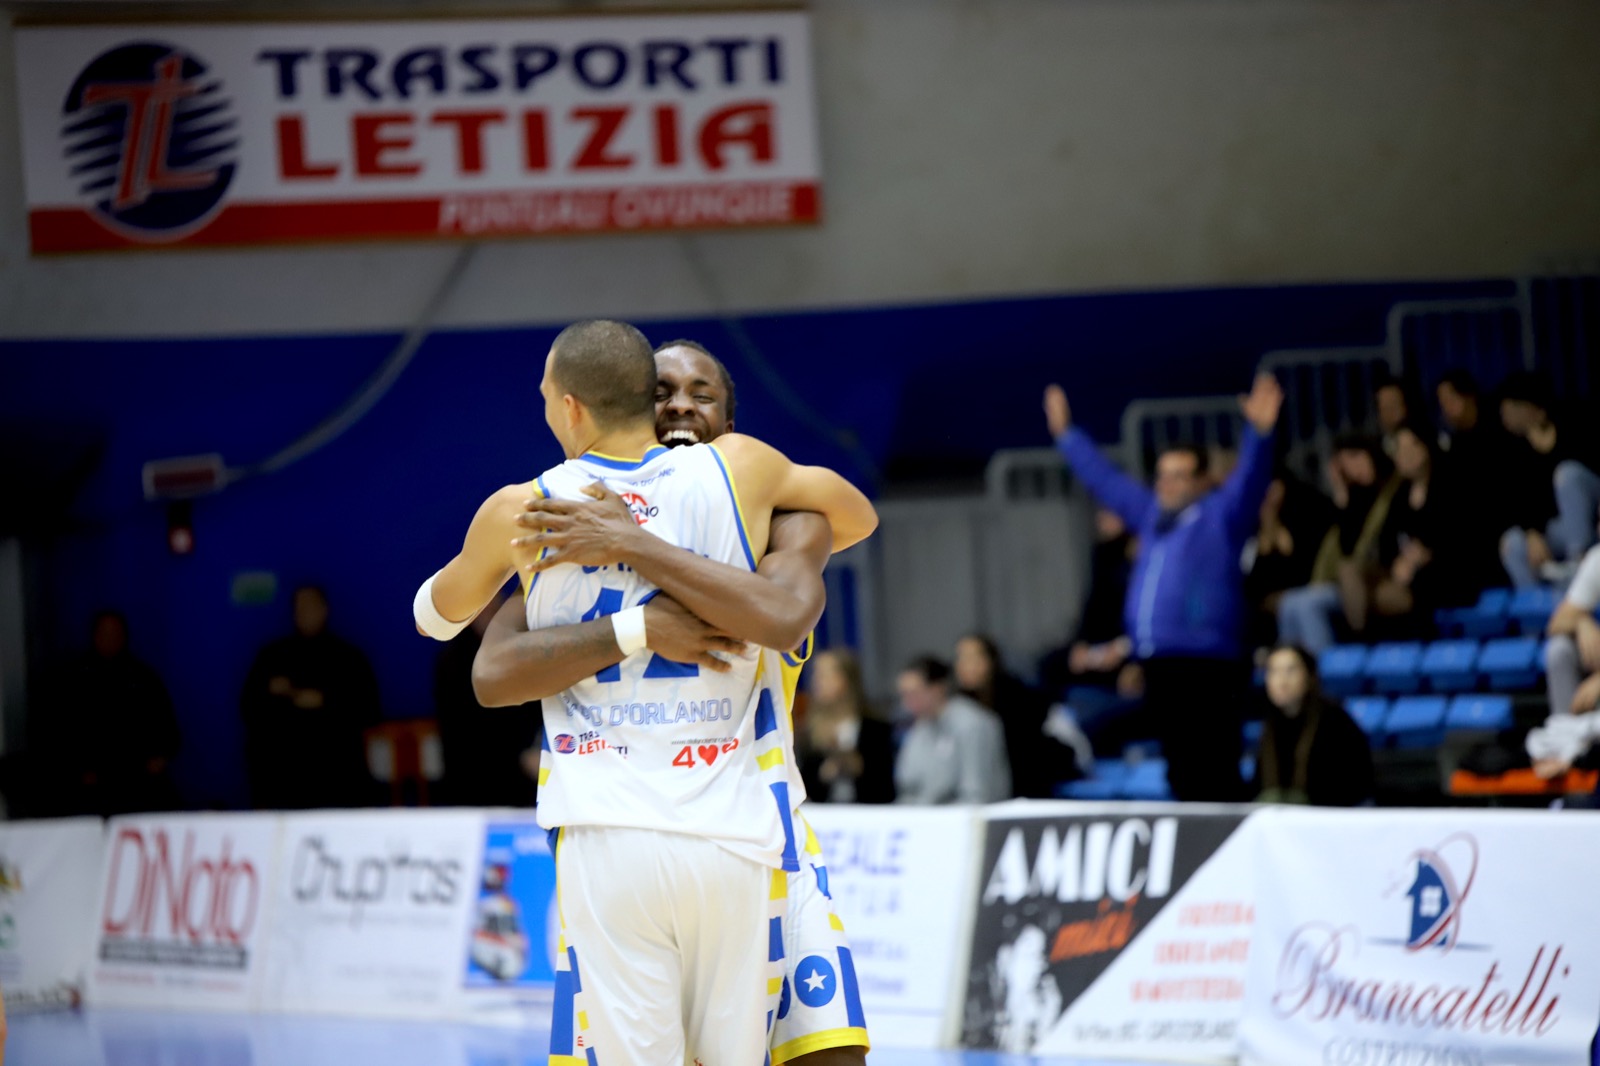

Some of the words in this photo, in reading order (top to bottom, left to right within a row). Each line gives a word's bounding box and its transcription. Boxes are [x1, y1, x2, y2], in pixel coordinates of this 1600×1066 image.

[257, 38, 786, 100] TRASPORTI
[274, 100, 778, 180] LETIZIA
[609, 698, 733, 727] D'ORLANDO
[815, 829, 907, 875] EALE
[983, 816, 1179, 905] AMICI
[1271, 921, 1571, 1037] Brancatelli
